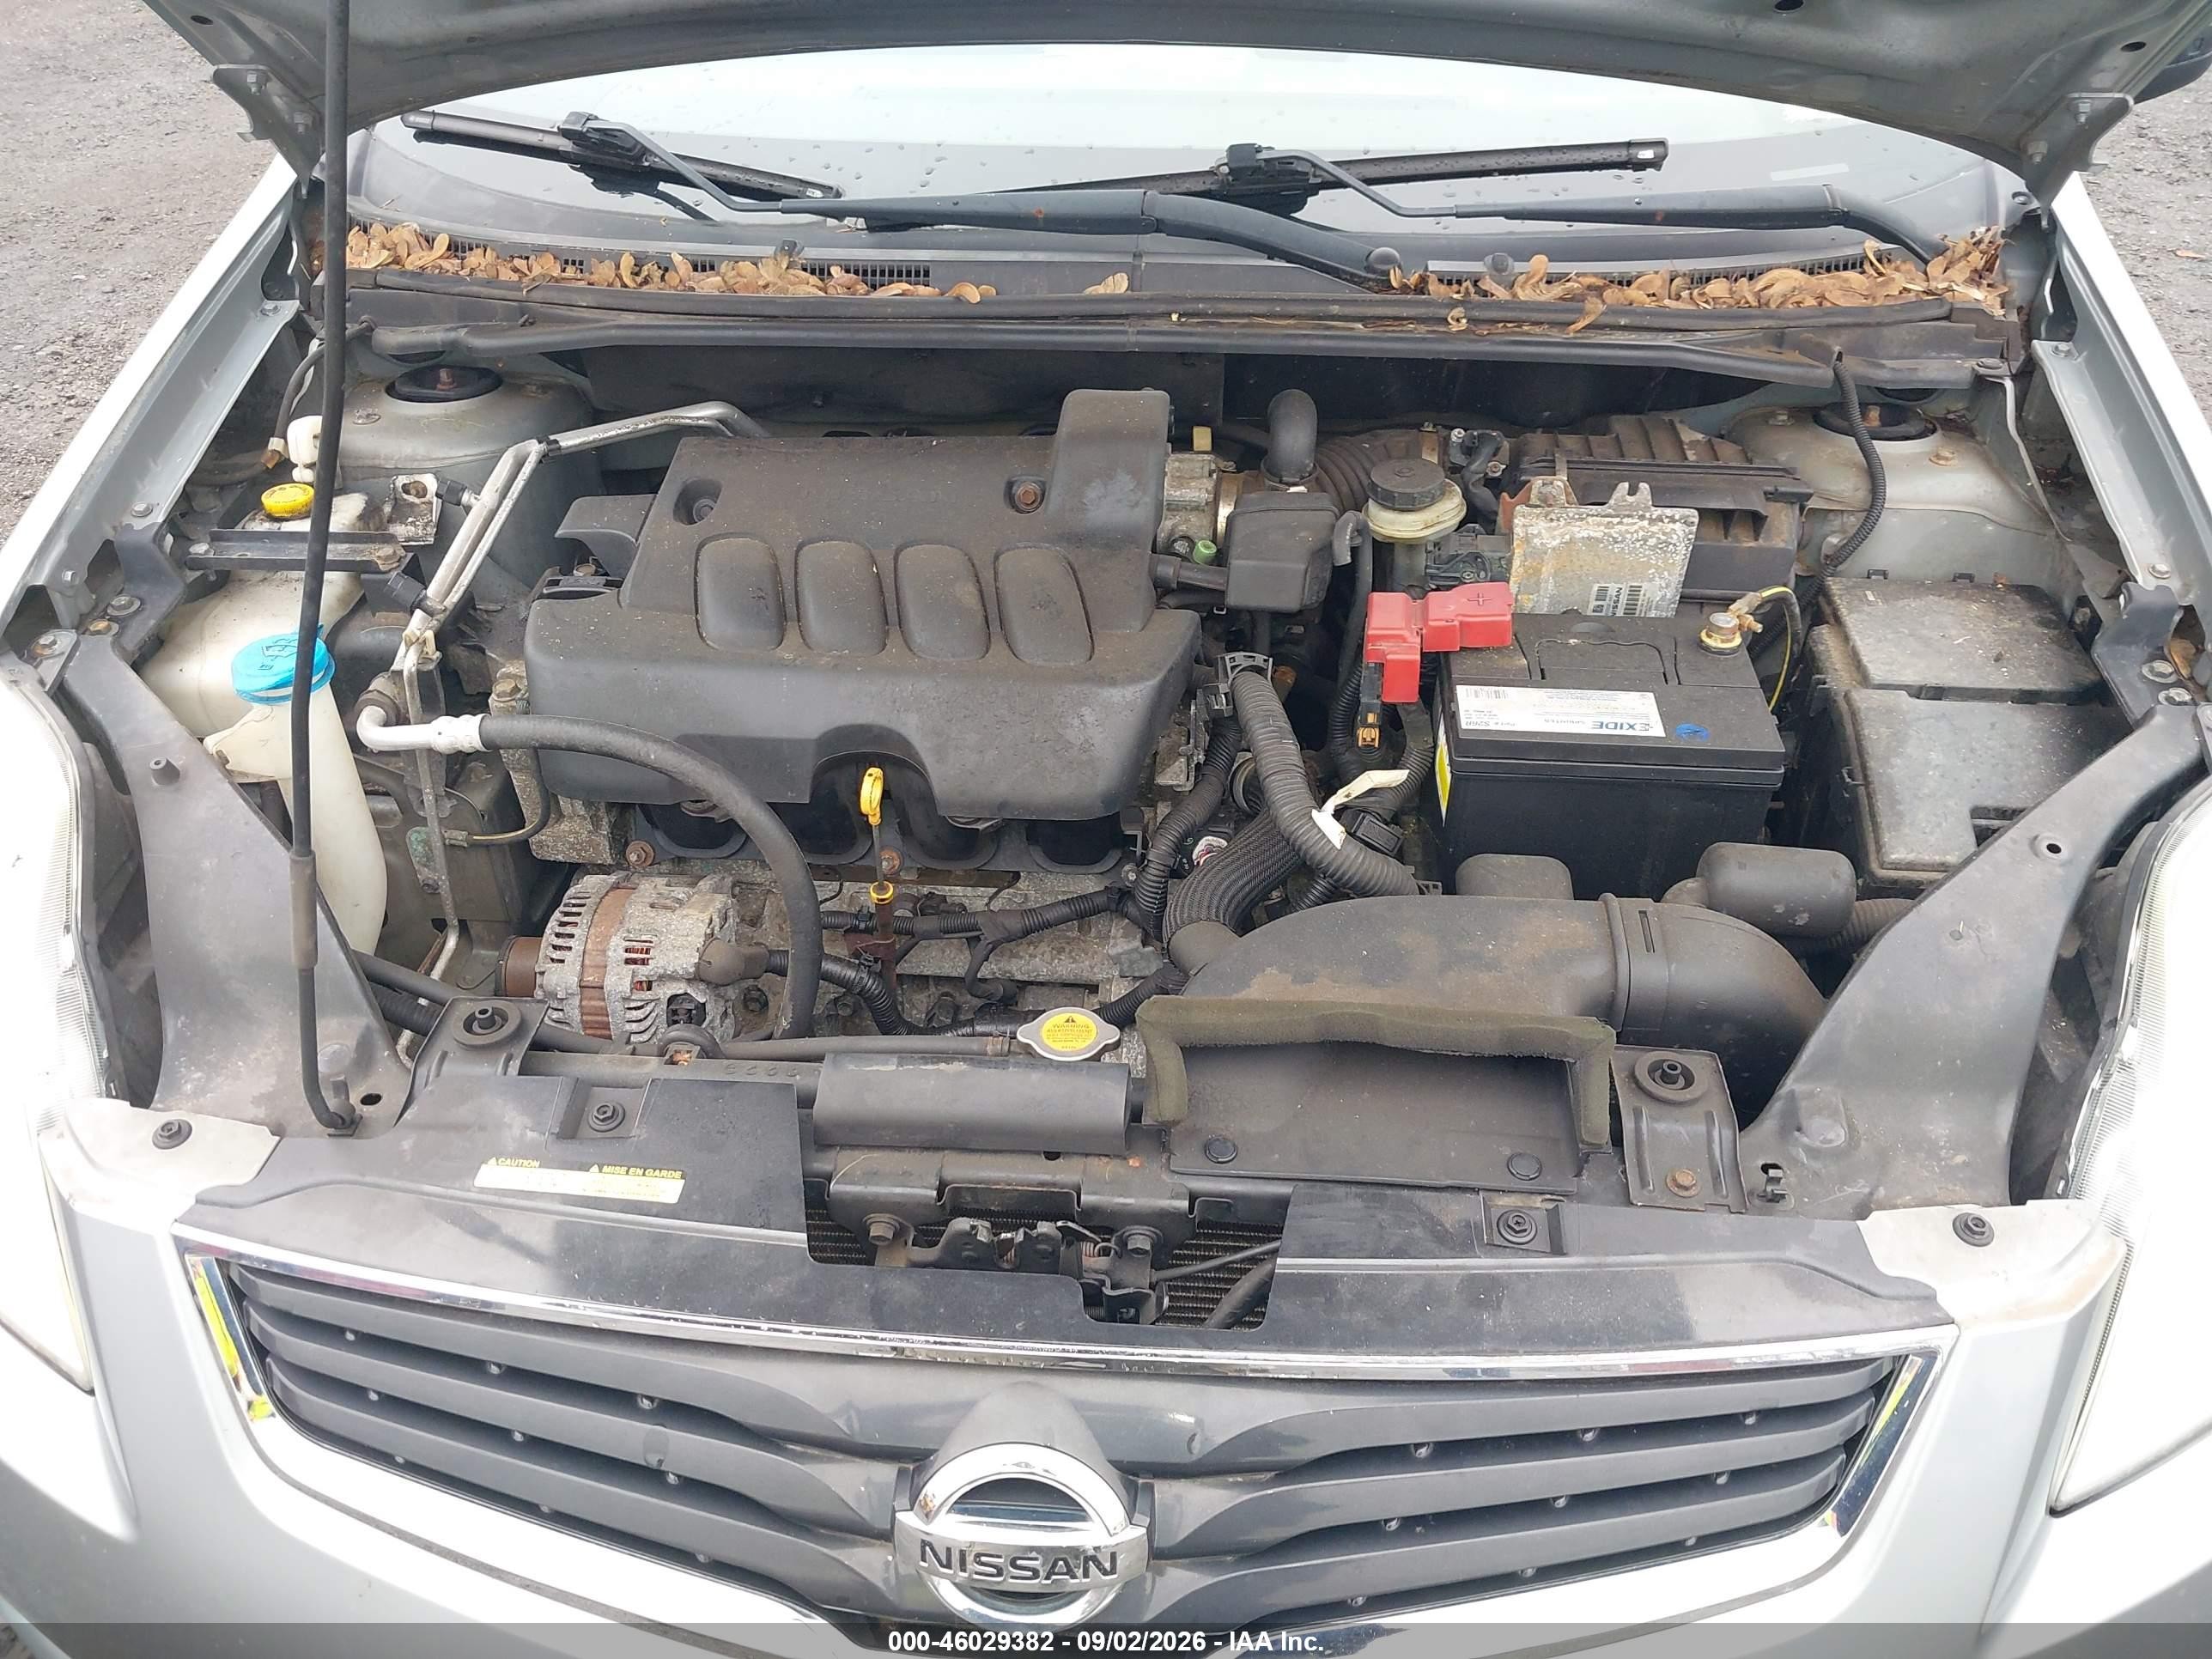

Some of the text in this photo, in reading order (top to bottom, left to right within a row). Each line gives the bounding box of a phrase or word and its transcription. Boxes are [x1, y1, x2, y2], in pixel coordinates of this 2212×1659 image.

[1591, 720, 1650, 731] EXIDE
[498, 1158, 540, 1168] CAUTION
[602, 1164, 682, 1179] MISE EN GARDE
[920, 1538, 1118, 1584] NISSAN
